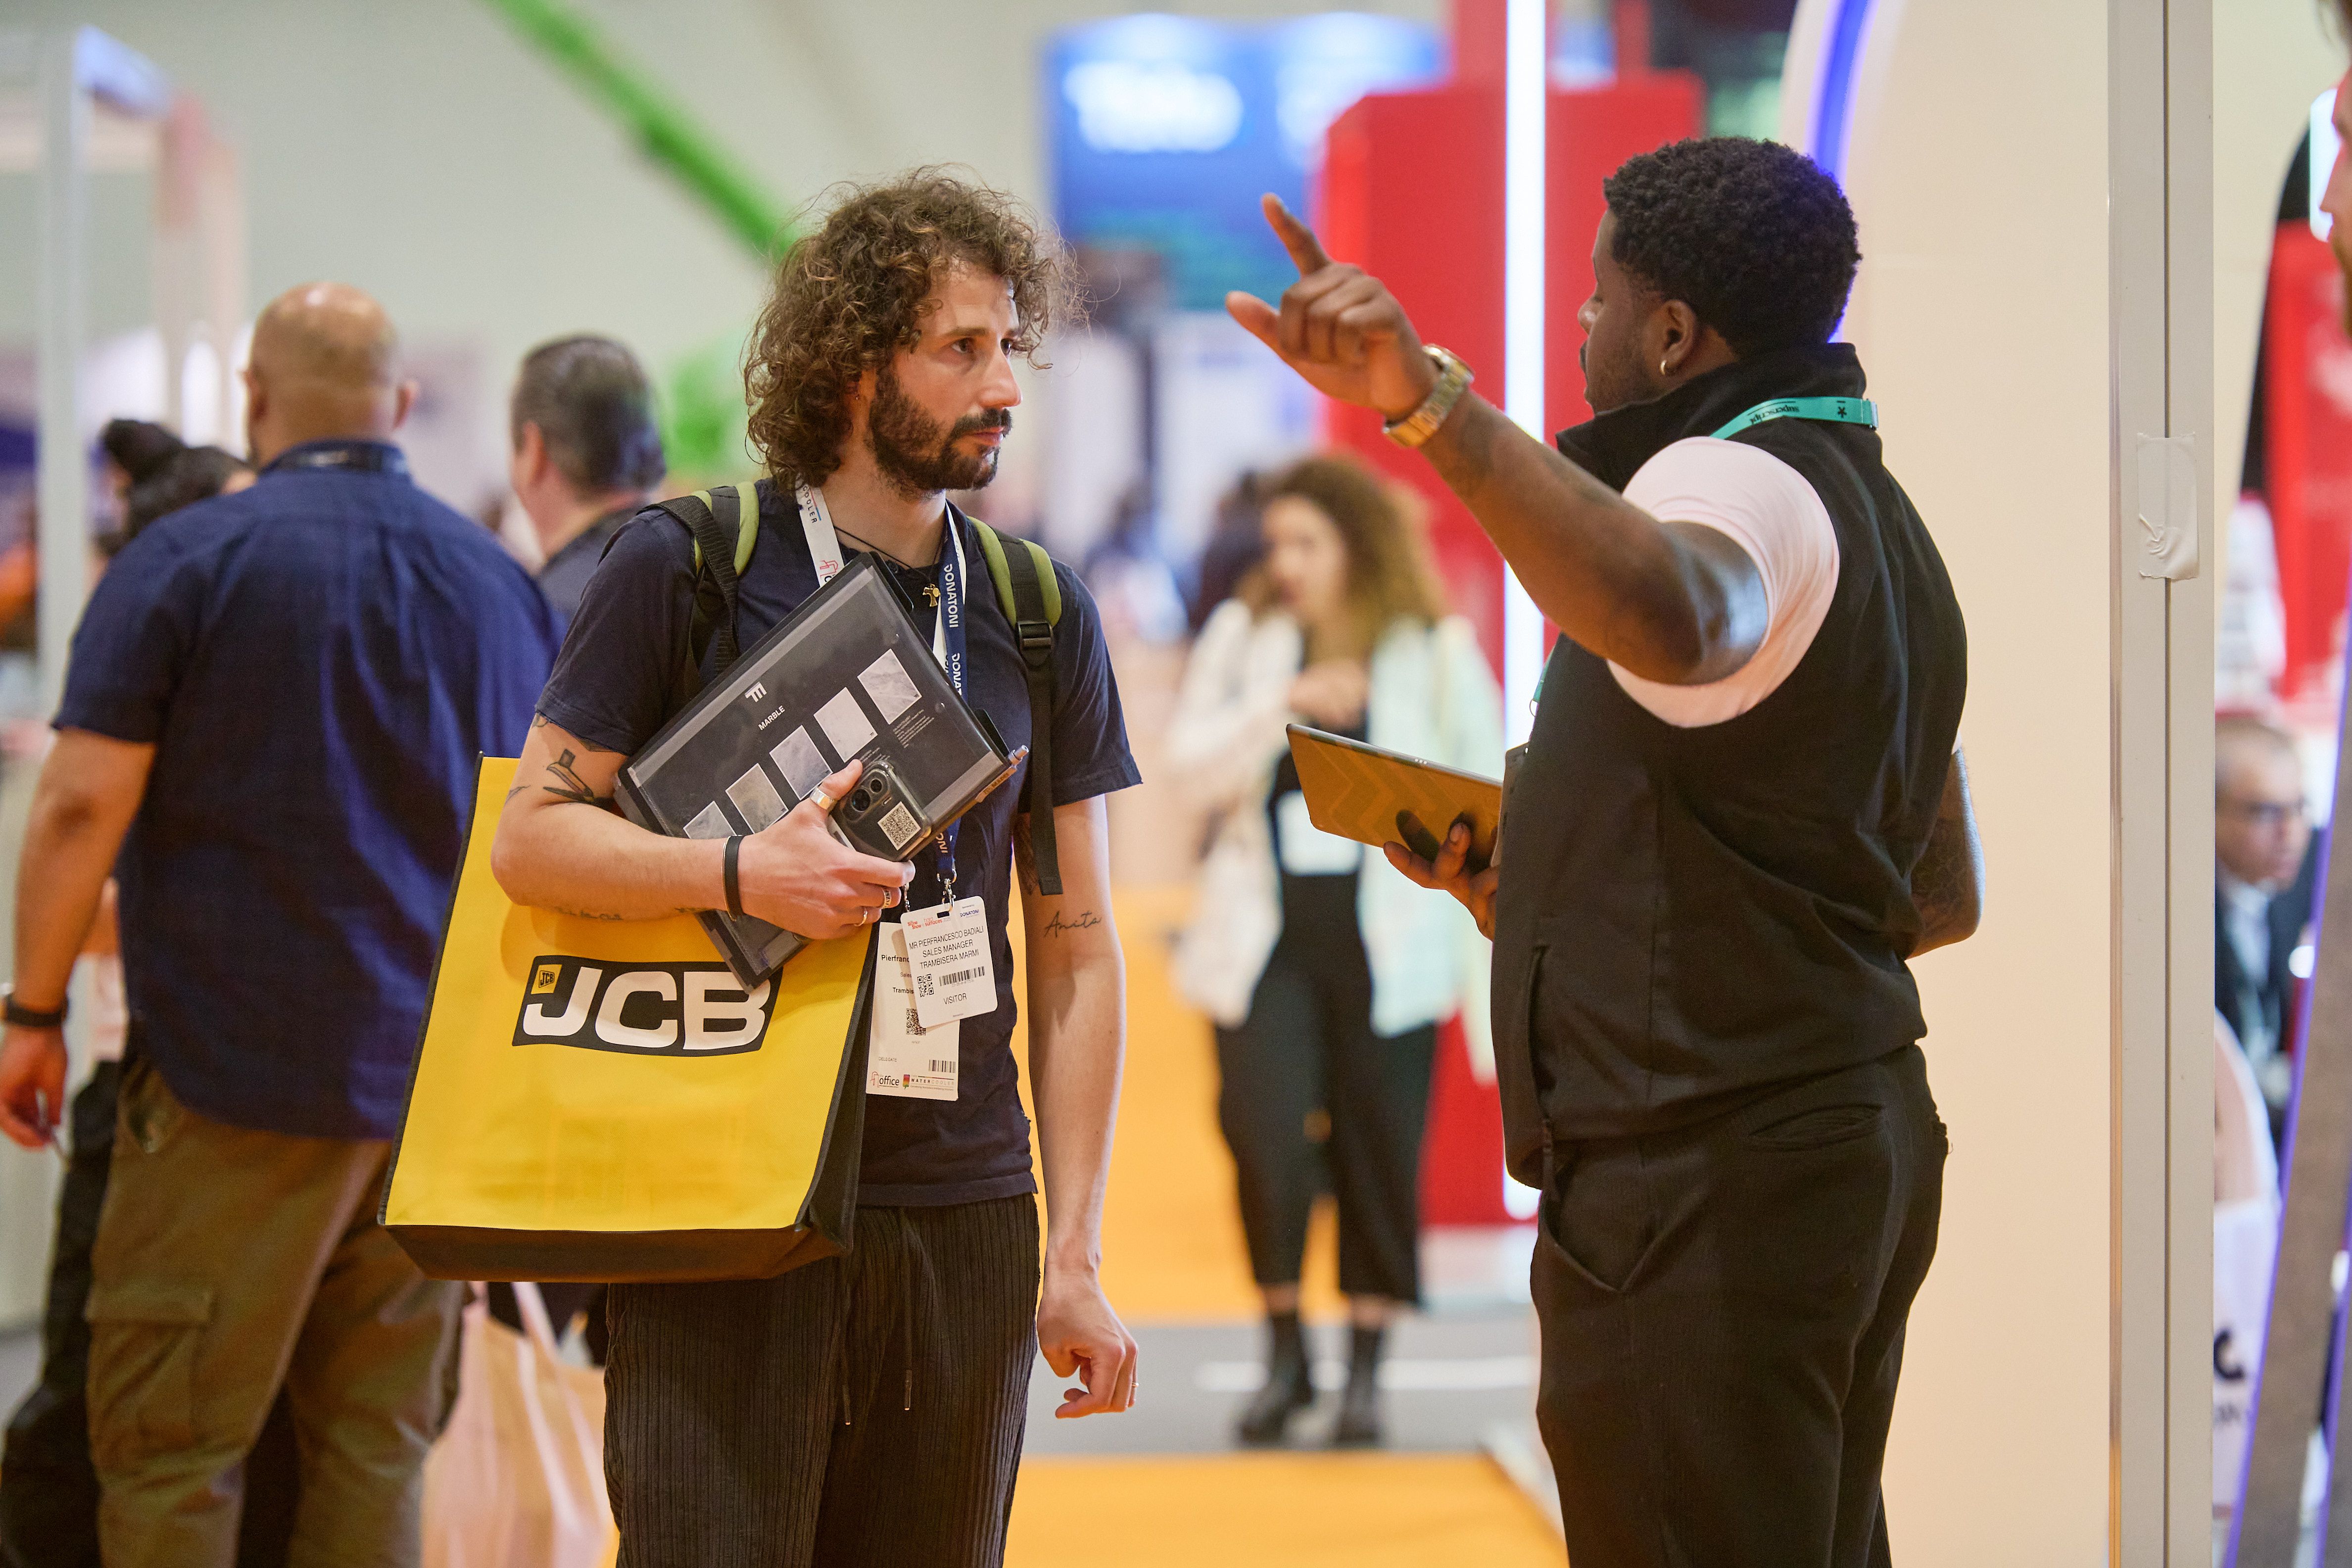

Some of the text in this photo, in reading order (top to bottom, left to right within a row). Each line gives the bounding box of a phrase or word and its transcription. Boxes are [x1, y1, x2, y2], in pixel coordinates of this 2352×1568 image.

[944, 563, 959, 628] DONATONI
[758, 705, 785, 730] MARBLE
[960, 909, 980, 917] DONATONI
[1044, 910, 1103, 938] Anita
[918, 931, 963, 948] PIERFRANCESCO
[964, 926, 984, 937] BADIALI
[922, 940, 973, 957] SALES MANAGER
[919, 949, 979, 969] TRAMBISERA MARMI
[540, 971, 555, 987] JCB
[523, 966, 771, 1050] JCB
[943, 993, 967, 1004] VISITOR
[879, 1075, 900, 1086] office
